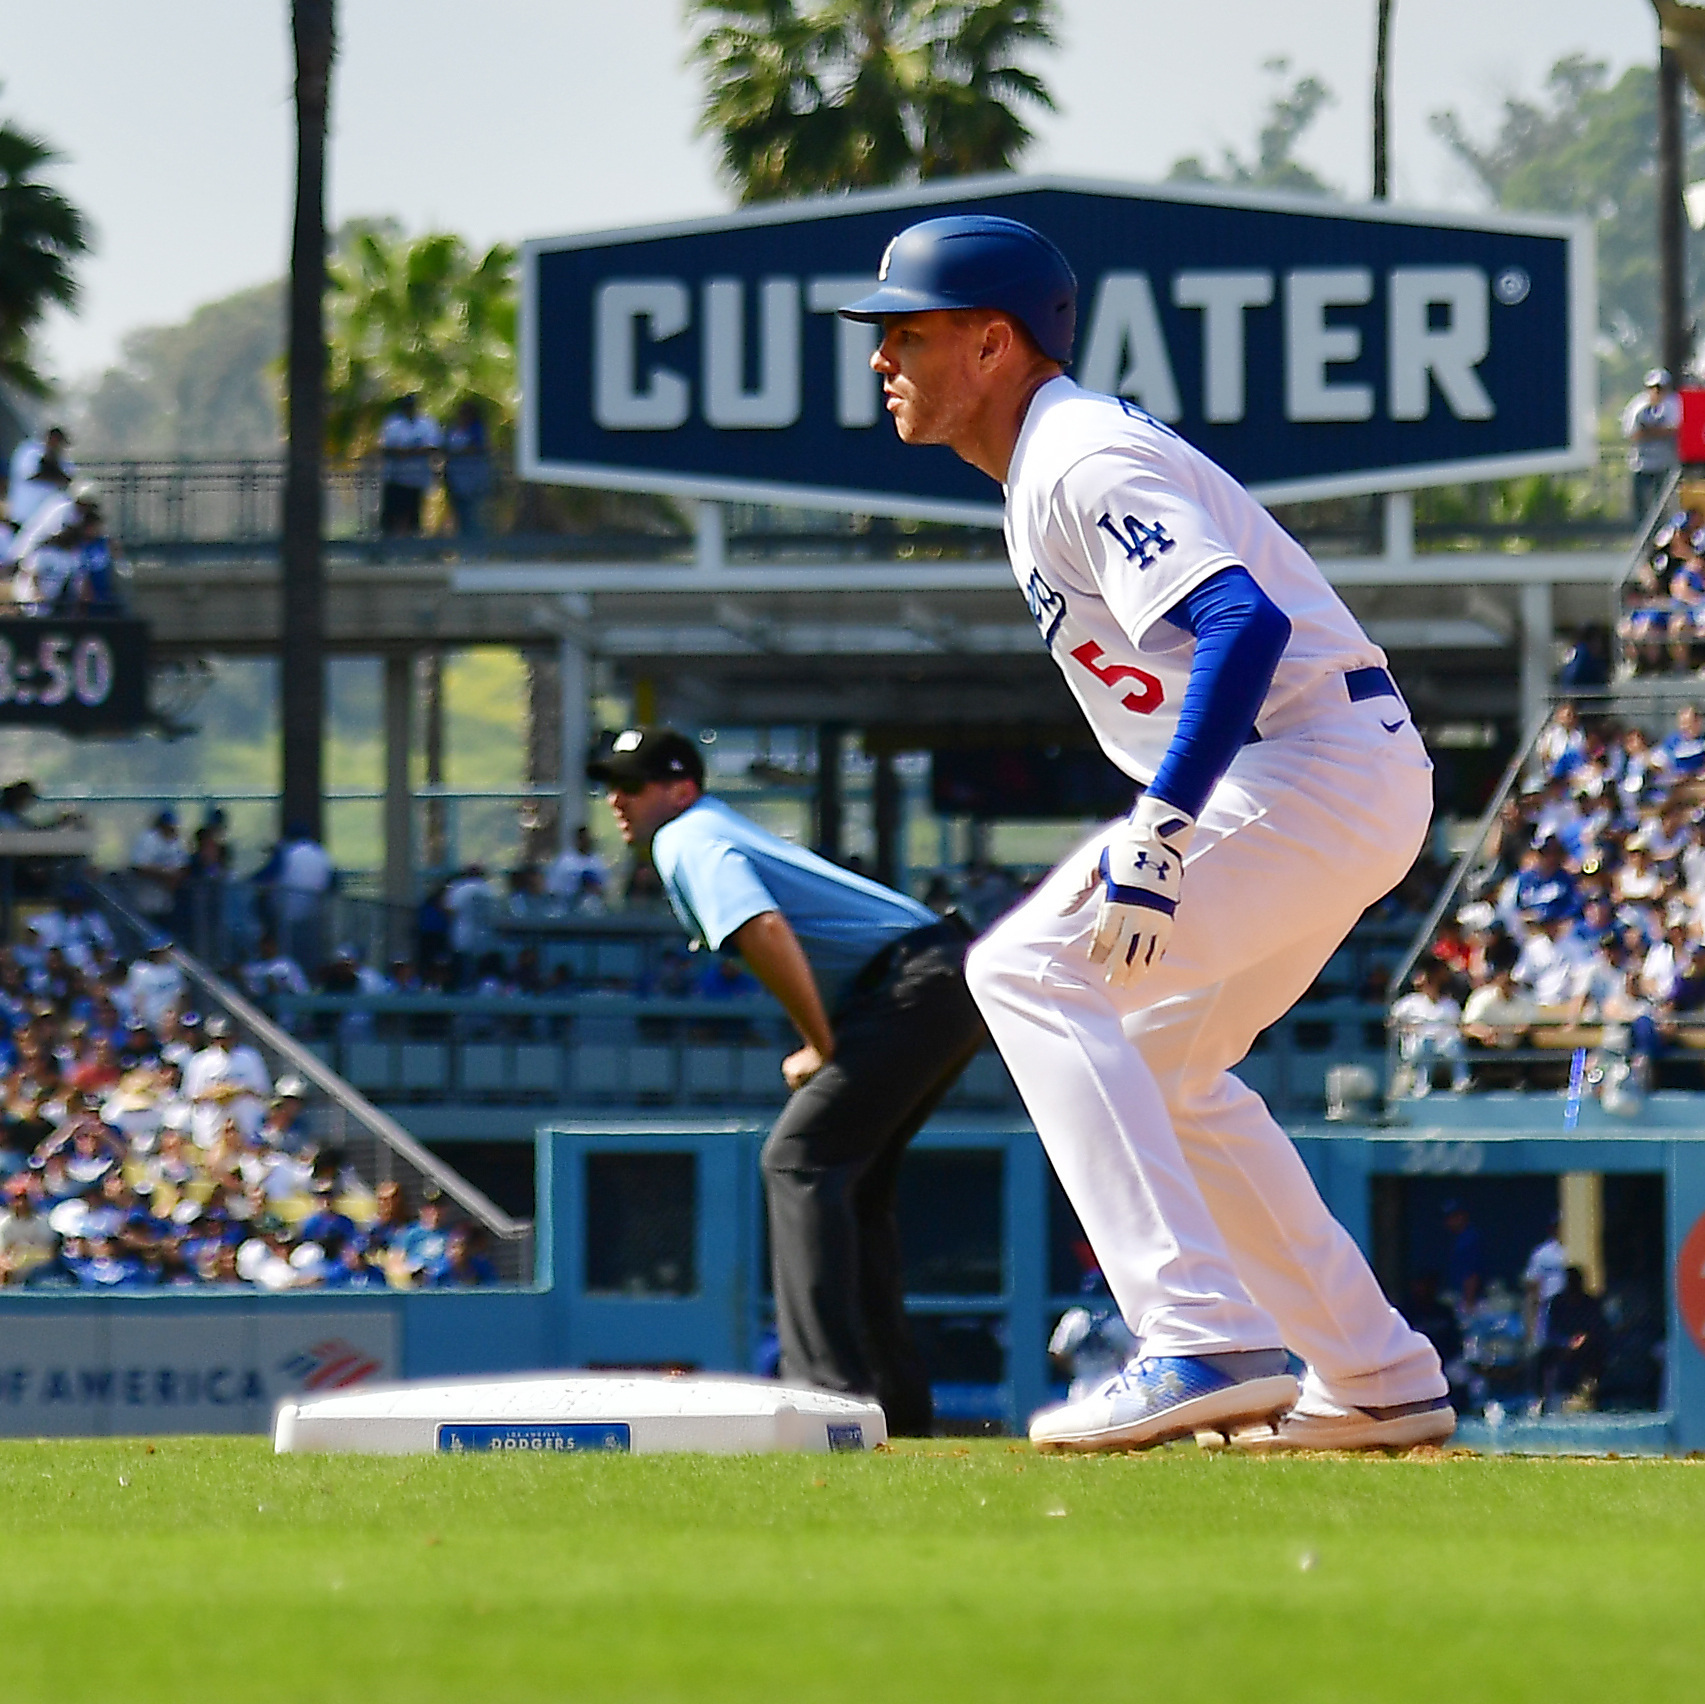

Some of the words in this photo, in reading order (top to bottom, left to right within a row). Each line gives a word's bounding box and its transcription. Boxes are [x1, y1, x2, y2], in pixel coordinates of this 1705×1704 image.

[593, 263, 1496, 431] CUTATER
[1096, 512, 1177, 572] LA
[1071, 640, 1165, 715] 5
[38, 1366, 267, 1406] AMERICA
[491, 1437, 576, 1451] DODGERS
